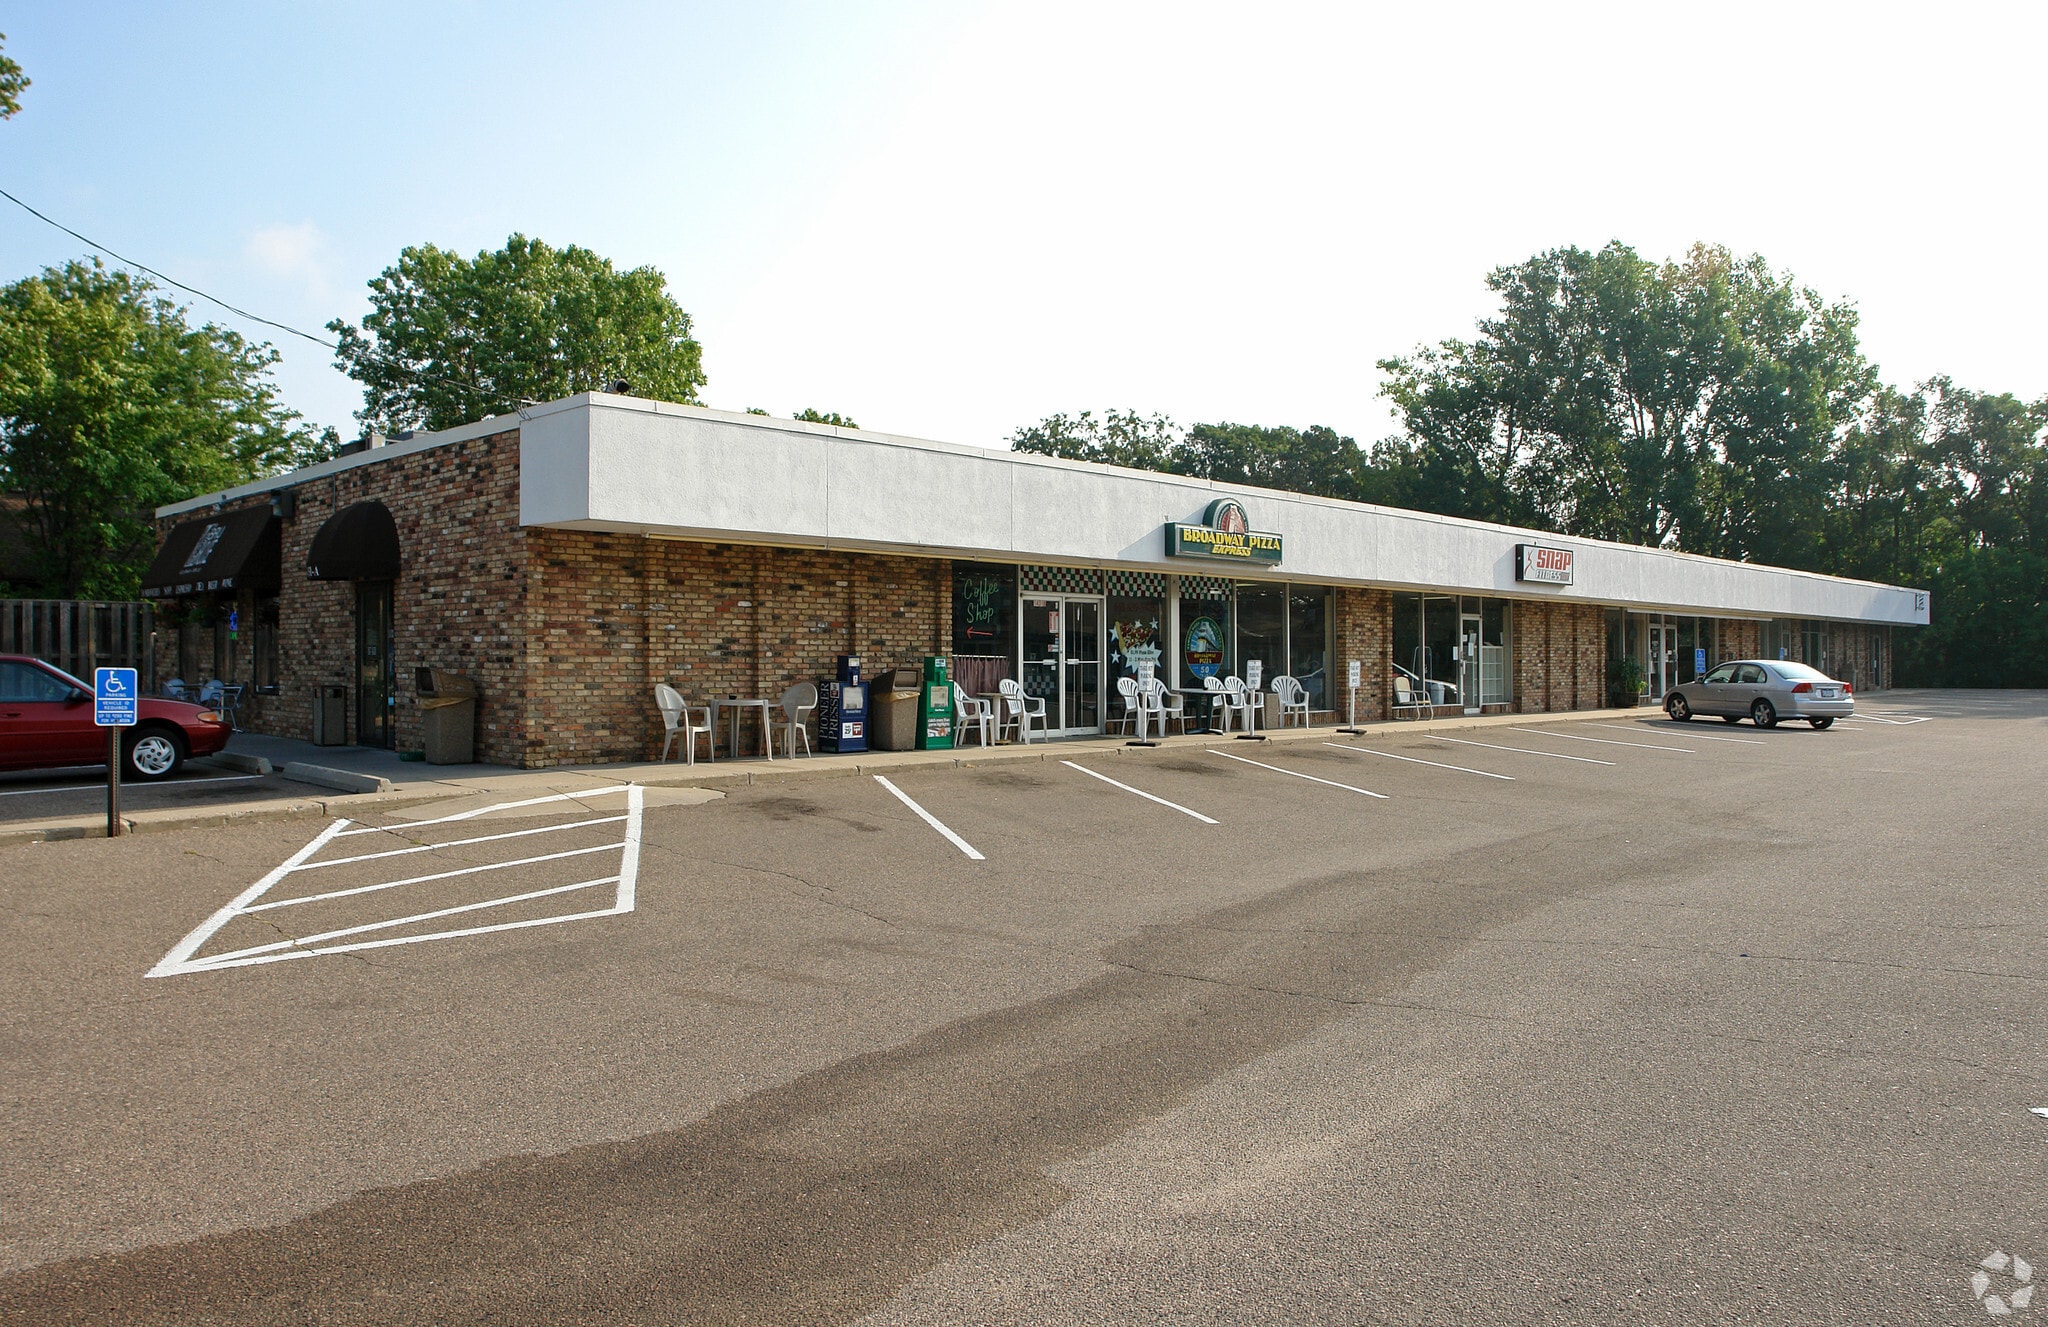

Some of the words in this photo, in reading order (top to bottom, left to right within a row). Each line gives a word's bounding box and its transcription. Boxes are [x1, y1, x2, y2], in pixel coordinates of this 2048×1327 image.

[1183, 529, 1245, 546] BROADWAY
[1249, 536, 1281, 550] PIZZA
[1212, 544, 1252, 557] EXPRESS
[963, 577, 999, 607] Coffee
[966, 602, 994, 624] Shop
[819, 682, 830, 739] PIONEER
[828, 698, 839, 740] PRESS
